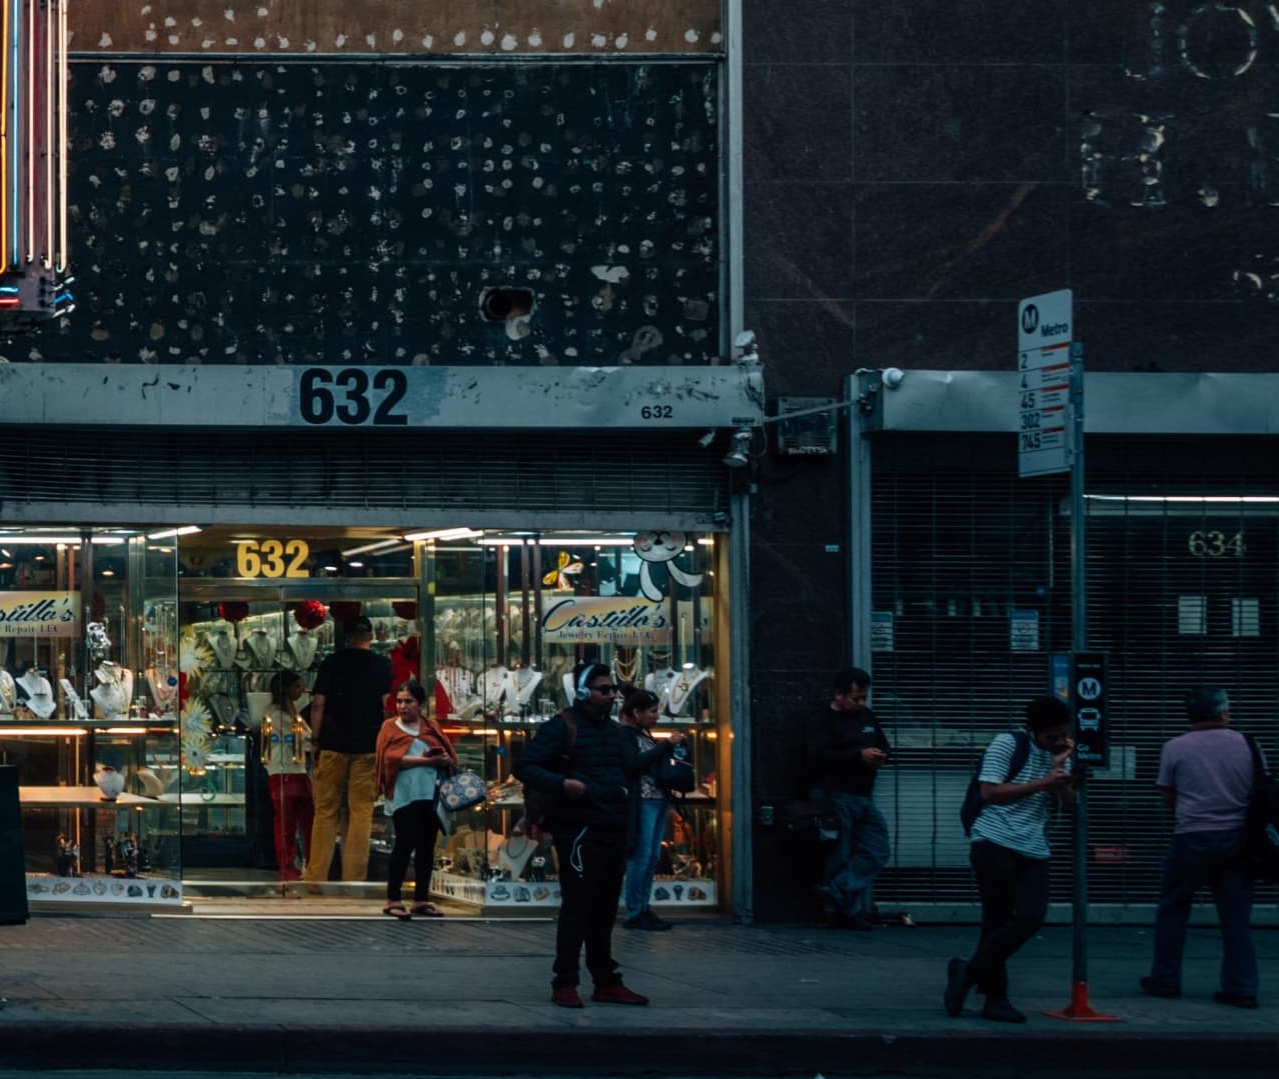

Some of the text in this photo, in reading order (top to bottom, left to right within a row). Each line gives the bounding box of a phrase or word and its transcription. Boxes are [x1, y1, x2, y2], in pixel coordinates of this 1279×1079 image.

[1041, 323, 1068, 337] Metro
[1022, 353, 1028, 369] 2
[1021, 373, 1028, 389] 4
[299, 367, 409, 425] 632
[1022, 392, 1035, 409] 45
[641, 405, 673, 420] 632
[1022, 412, 1040, 430] 302
[1022, 432, 1041, 451] 745
[1187, 529, 1245, 557] 634
[236, 539, 311, 579] 632
[542, 599, 667, 632] Castillo's
[5, 624, 35, 636] Repair
[558, 630, 594, 641] Jewelry
